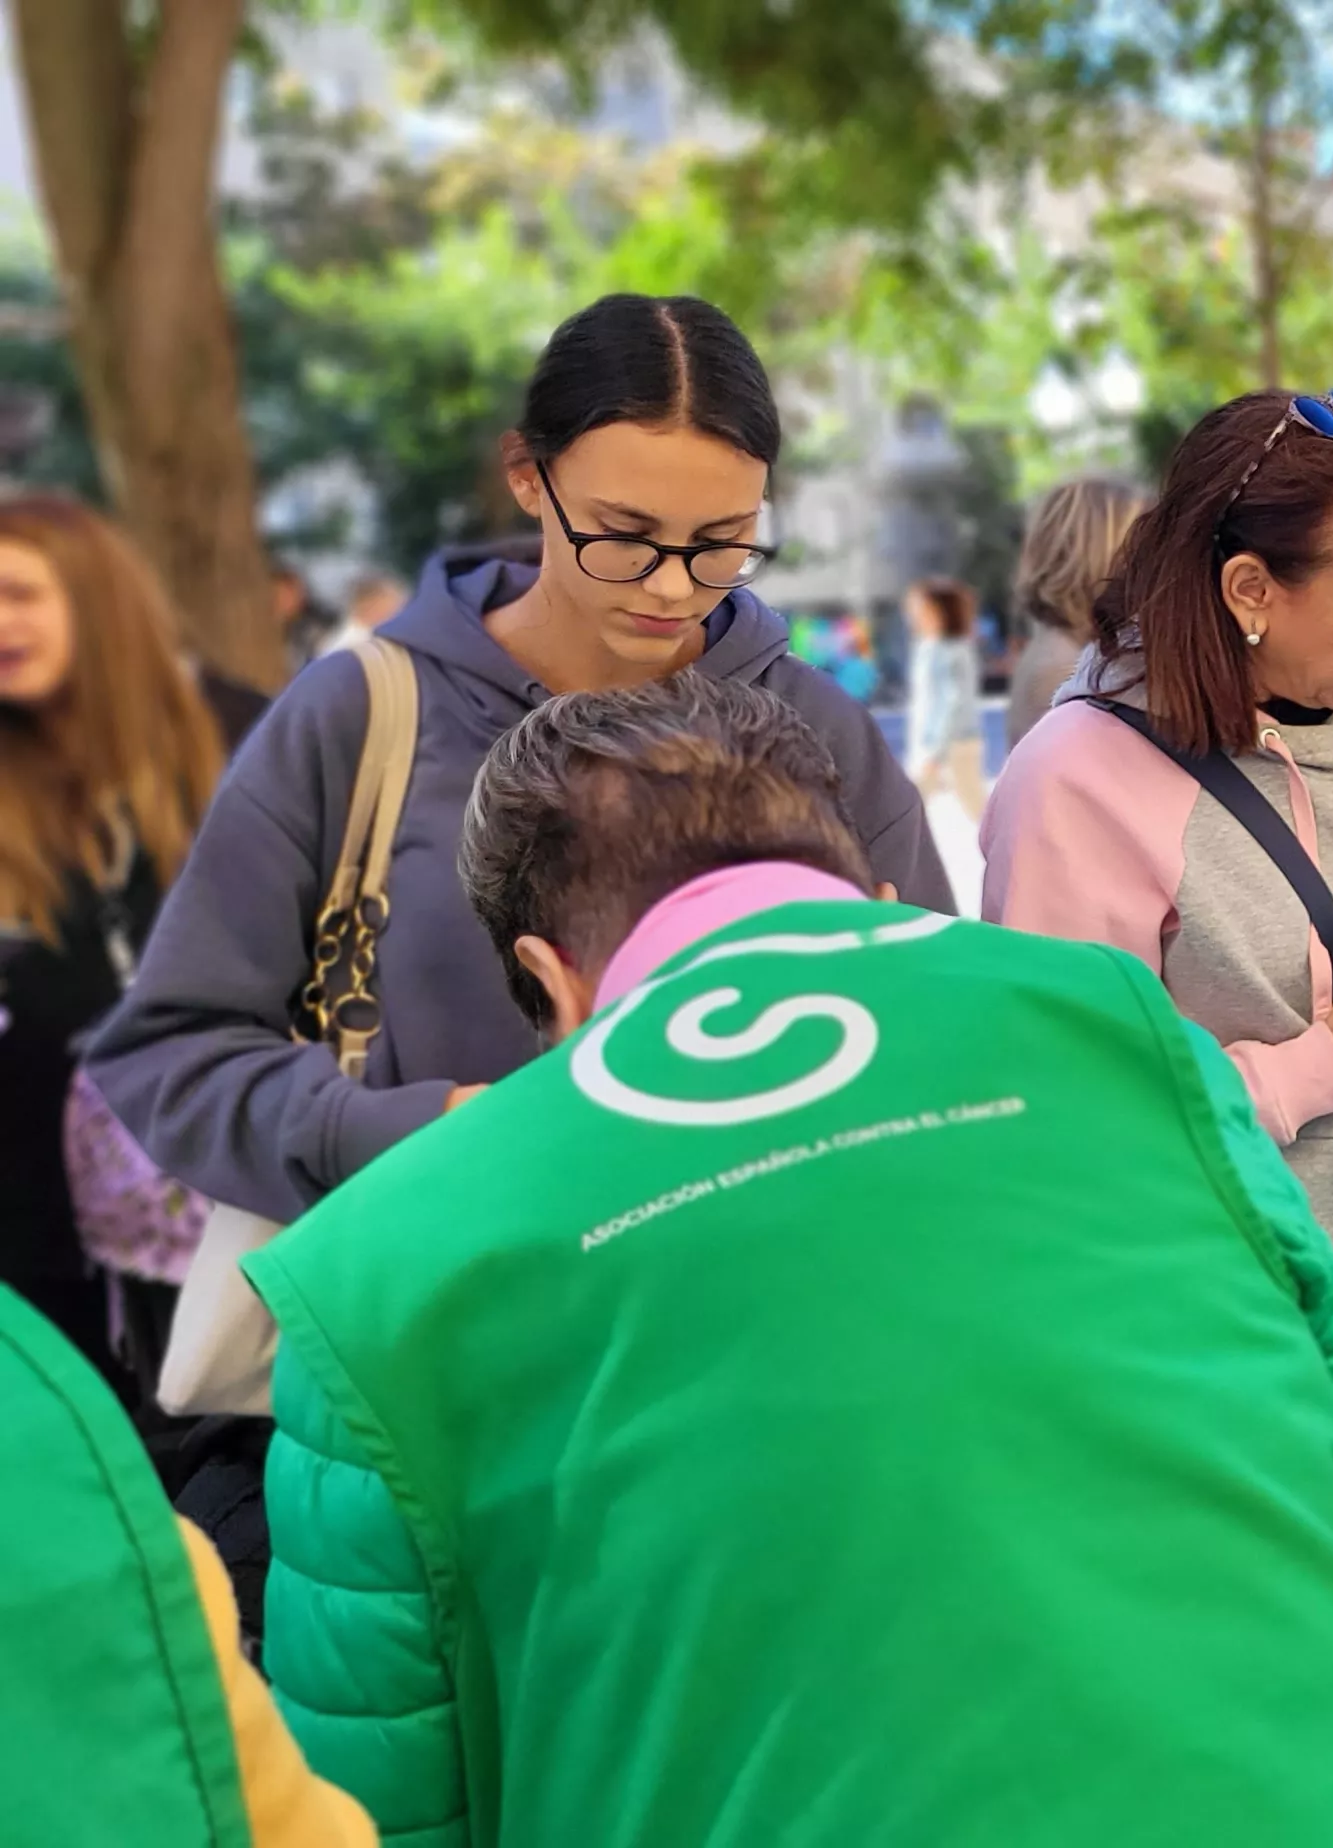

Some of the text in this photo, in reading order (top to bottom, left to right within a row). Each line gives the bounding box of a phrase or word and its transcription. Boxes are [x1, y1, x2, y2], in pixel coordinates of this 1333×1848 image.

[581, 1096, 1027, 1251] ASOCIACIÓN ESPAÑOLA CONTRA EL CÁNCER
